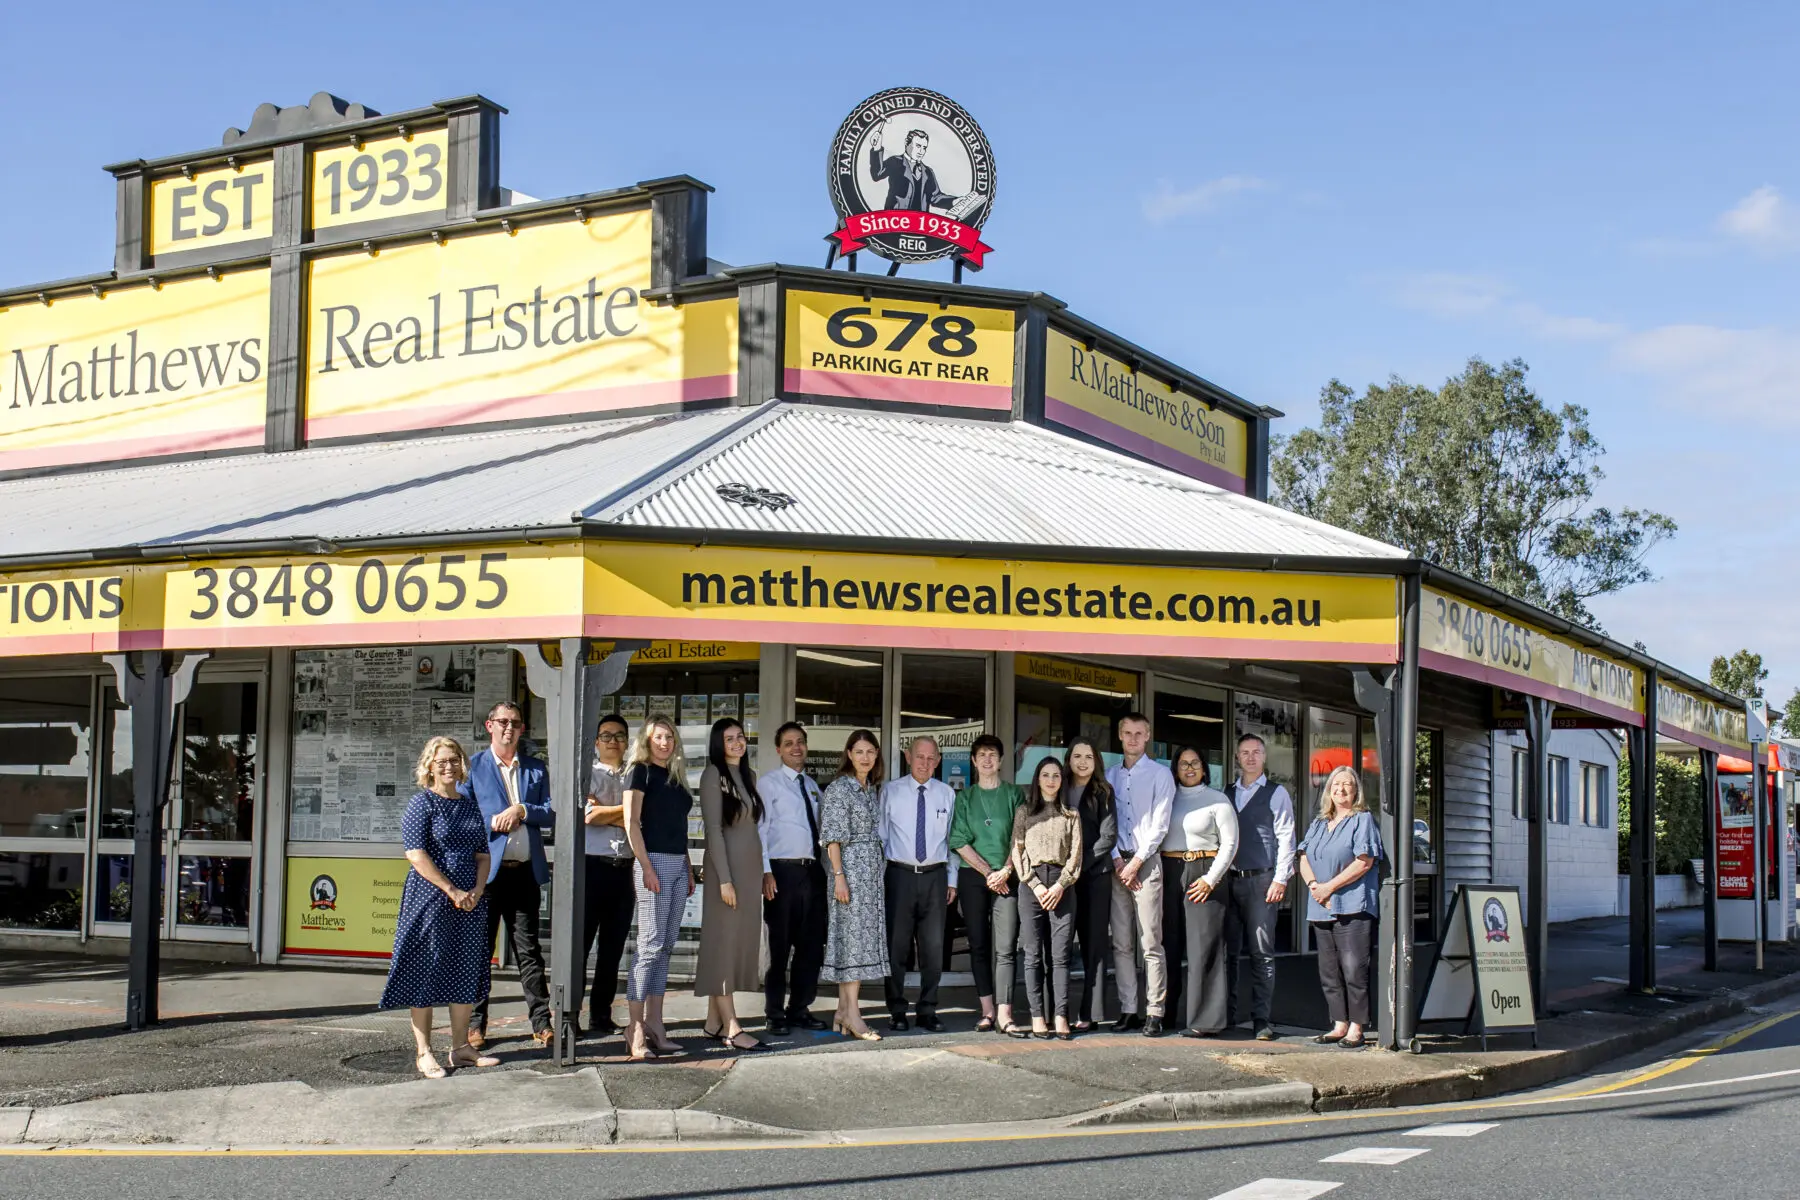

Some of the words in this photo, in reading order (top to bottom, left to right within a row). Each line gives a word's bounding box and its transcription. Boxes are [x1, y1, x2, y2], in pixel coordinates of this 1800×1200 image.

[840, 121, 864, 175] FAMILY
[863, 96, 915, 123] OWNED
[920, 99, 951, 119] AND
[953, 117, 988, 192] OPERATED
[321, 143, 443, 216] 1933
[171, 173, 264, 240] EST
[860, 214, 910, 233] Since
[918, 216, 962, 241] 1933
[899, 238, 927, 252] REIQ
[318, 292, 442, 374] Real
[458, 277, 640, 357] Estate
[826, 306, 978, 358] 678
[9, 330, 262, 410] Matthews
[811, 350, 902, 376] PARKING
[907, 360, 934, 377] AT
[936, 362, 990, 382] REAR
[1090, 354, 1178, 427] Matthews
[1180, 400, 1195, 435] &
[1196, 407, 1226, 448] Son
[1200, 441, 1213, 461] Pty
[1213, 446, 1226, 465] Ltd
[190, 562, 334, 620] 3848
[355, 552, 510, 614] 0655
[682, 565, 1322, 628] matthewsrealestate.com.au
[1435, 596, 1486, 657] 3848
[1489, 616, 1533, 672] 0655
[355, 649, 367, 659] The
[637, 643, 672, 659] Real
[679, 641, 728, 659] Estate
[1028, 659, 1072, 681] Matthews
[1073, 665, 1092, 682] Real
[1093, 670, 1117, 687] Estate
[1572, 649, 1634, 702] AUCTIONS
[1751, 700, 1763, 711] 1P
[1554, 719, 1577, 728] 1933
[372, 896, 399, 906] Property
[301, 913, 346, 927] Matthews
[371, 927, 388, 937] Body
[1491, 989, 1521, 1014] Open
